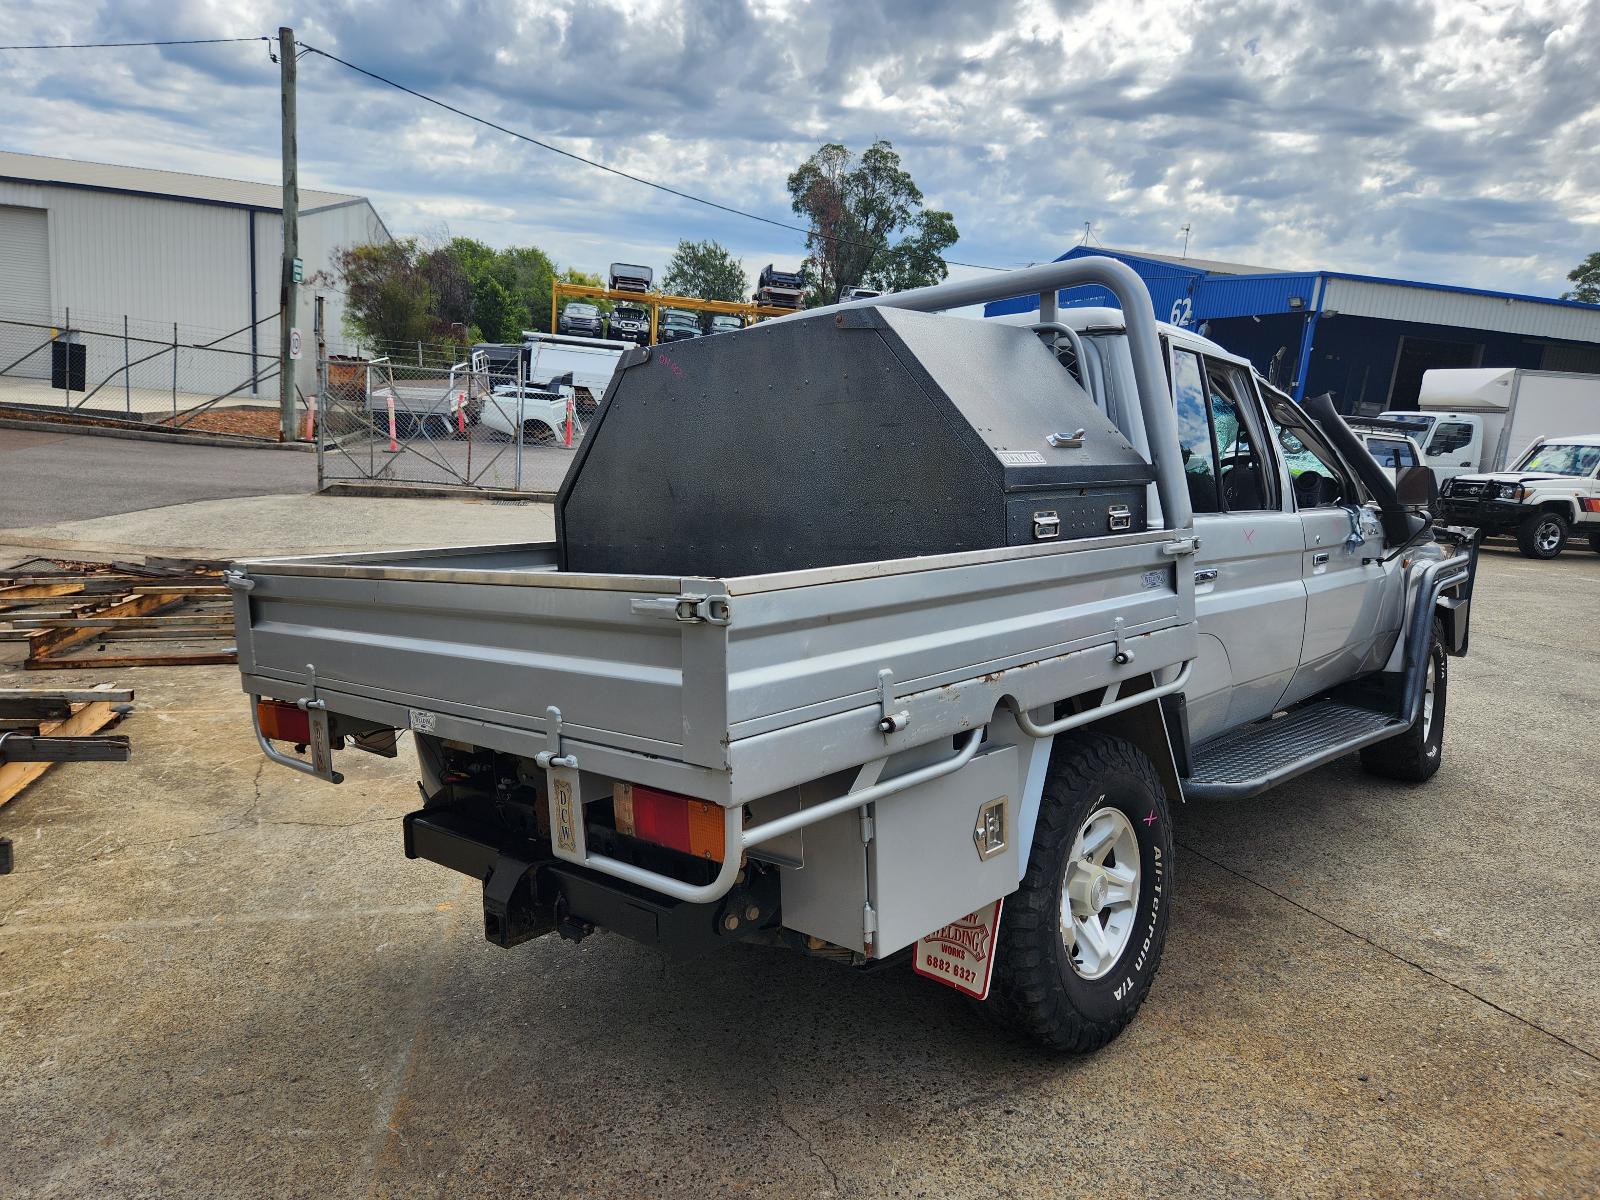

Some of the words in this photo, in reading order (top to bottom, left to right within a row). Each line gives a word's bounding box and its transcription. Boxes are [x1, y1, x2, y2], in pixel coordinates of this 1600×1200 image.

[1170, 298, 1192, 327] 62
[560, 790, 570, 840] DCW
[1127, 846, 1163, 972] All-Terrain
[941, 943, 966, 960] WORKS
[926, 954, 951, 973] 6882
[953, 964, 977, 983] 6327
